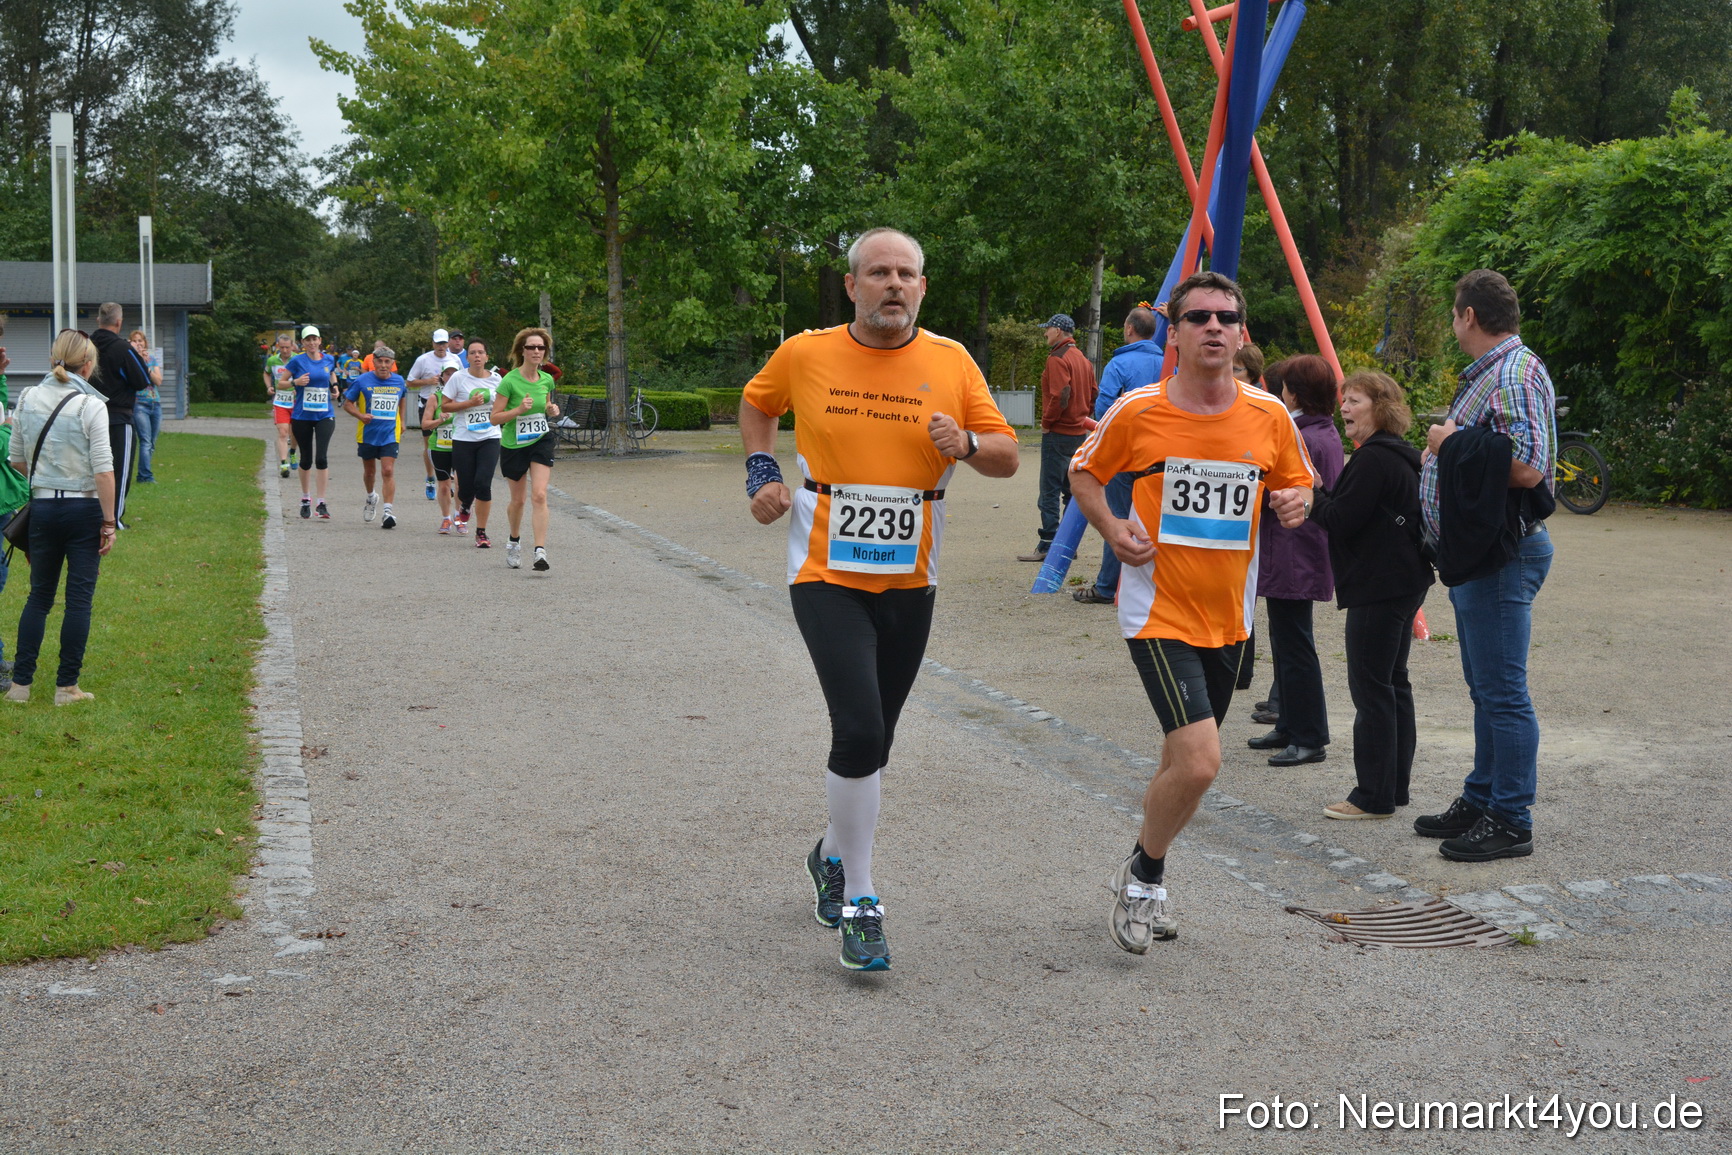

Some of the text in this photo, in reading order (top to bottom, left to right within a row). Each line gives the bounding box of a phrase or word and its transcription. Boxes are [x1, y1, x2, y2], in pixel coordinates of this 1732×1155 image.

[306, 392, 327, 402] 2412
[829, 388, 923, 406] Verein der Notärzte
[374, 400, 396, 410] 2807
[468, 411, 491, 424] 2257
[825, 405, 859, 416] Altdorf
[866, 409, 901, 421] Feucht
[903, 415, 921, 424] e.V.
[519, 420, 547, 433] 2138
[1166, 464, 1198, 476] PARTL
[1200, 468, 1245, 480] Neumarkt
[833, 490, 909, 504] PARTL Neumarkt
[1171, 479, 1249, 516] 3319
[839, 504, 915, 541] 2239
[852, 546, 896, 561] Norbert
